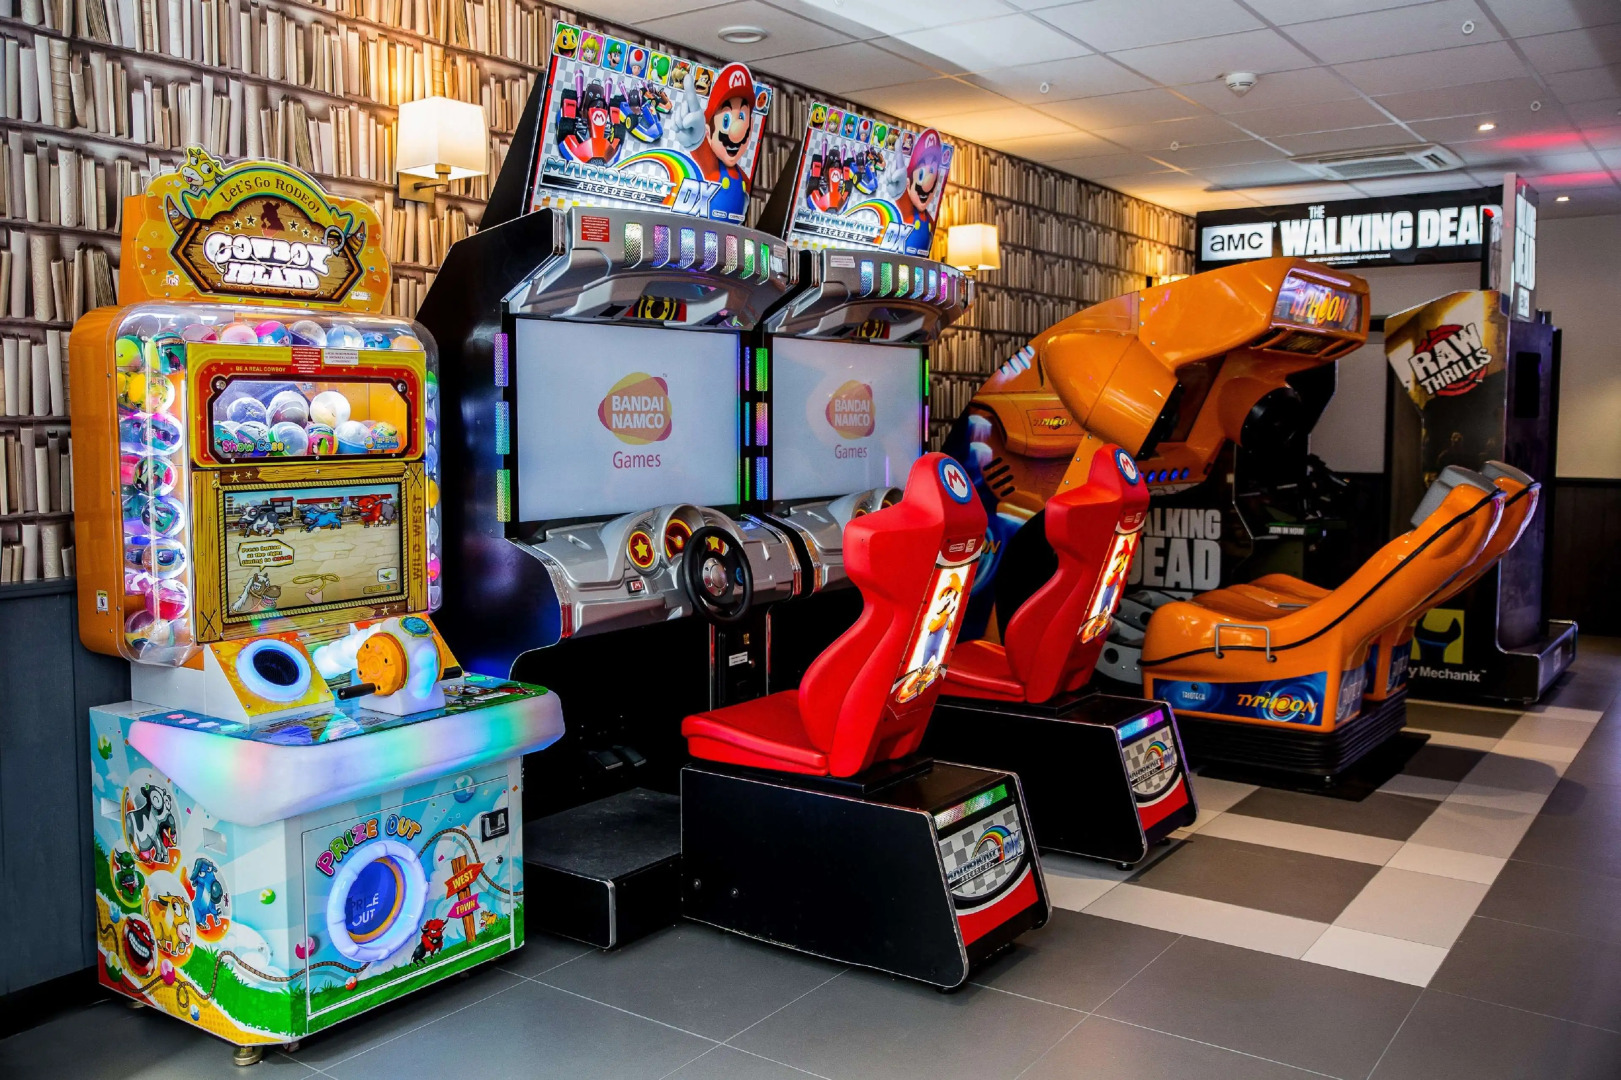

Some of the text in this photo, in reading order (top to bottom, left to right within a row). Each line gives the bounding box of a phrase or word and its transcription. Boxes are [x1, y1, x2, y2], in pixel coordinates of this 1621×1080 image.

[220, 177, 320, 214] Let's Go RODEO!
[577, 181, 626, 197] ARCADE
[671, 177, 722, 219] DX
[1308, 205, 1325, 219] THE
[816, 227, 851, 239] ARCADE
[879, 220, 915, 254] DX
[1280, 211, 1413, 257] WALKING
[203, 232, 333, 276] COWBOY
[223, 262, 320, 290] ISLAND
[1409, 323, 1483, 381] RAW
[1421, 348, 1492, 395] THRILLS
[612, 395, 664, 412] BANDAI
[835, 400, 870, 412] BANDAI
[612, 413, 665, 429] NAMCO
[835, 413, 870, 427] NAMCO
[221, 438, 286, 453] Show Case
[835, 444, 868, 459] Games
[613, 450, 662, 469] Games
[1142, 508, 1221, 540] ALKING
[412, 494, 422, 581] WILD WEST
[1420, 665, 1480, 682] Mechanix
[1237, 693, 1319, 715] TYPHOON
[316, 814, 422, 876] PRIZE OUT
[452, 869, 473, 889] WEST
[455, 899, 476, 915] TOWN
